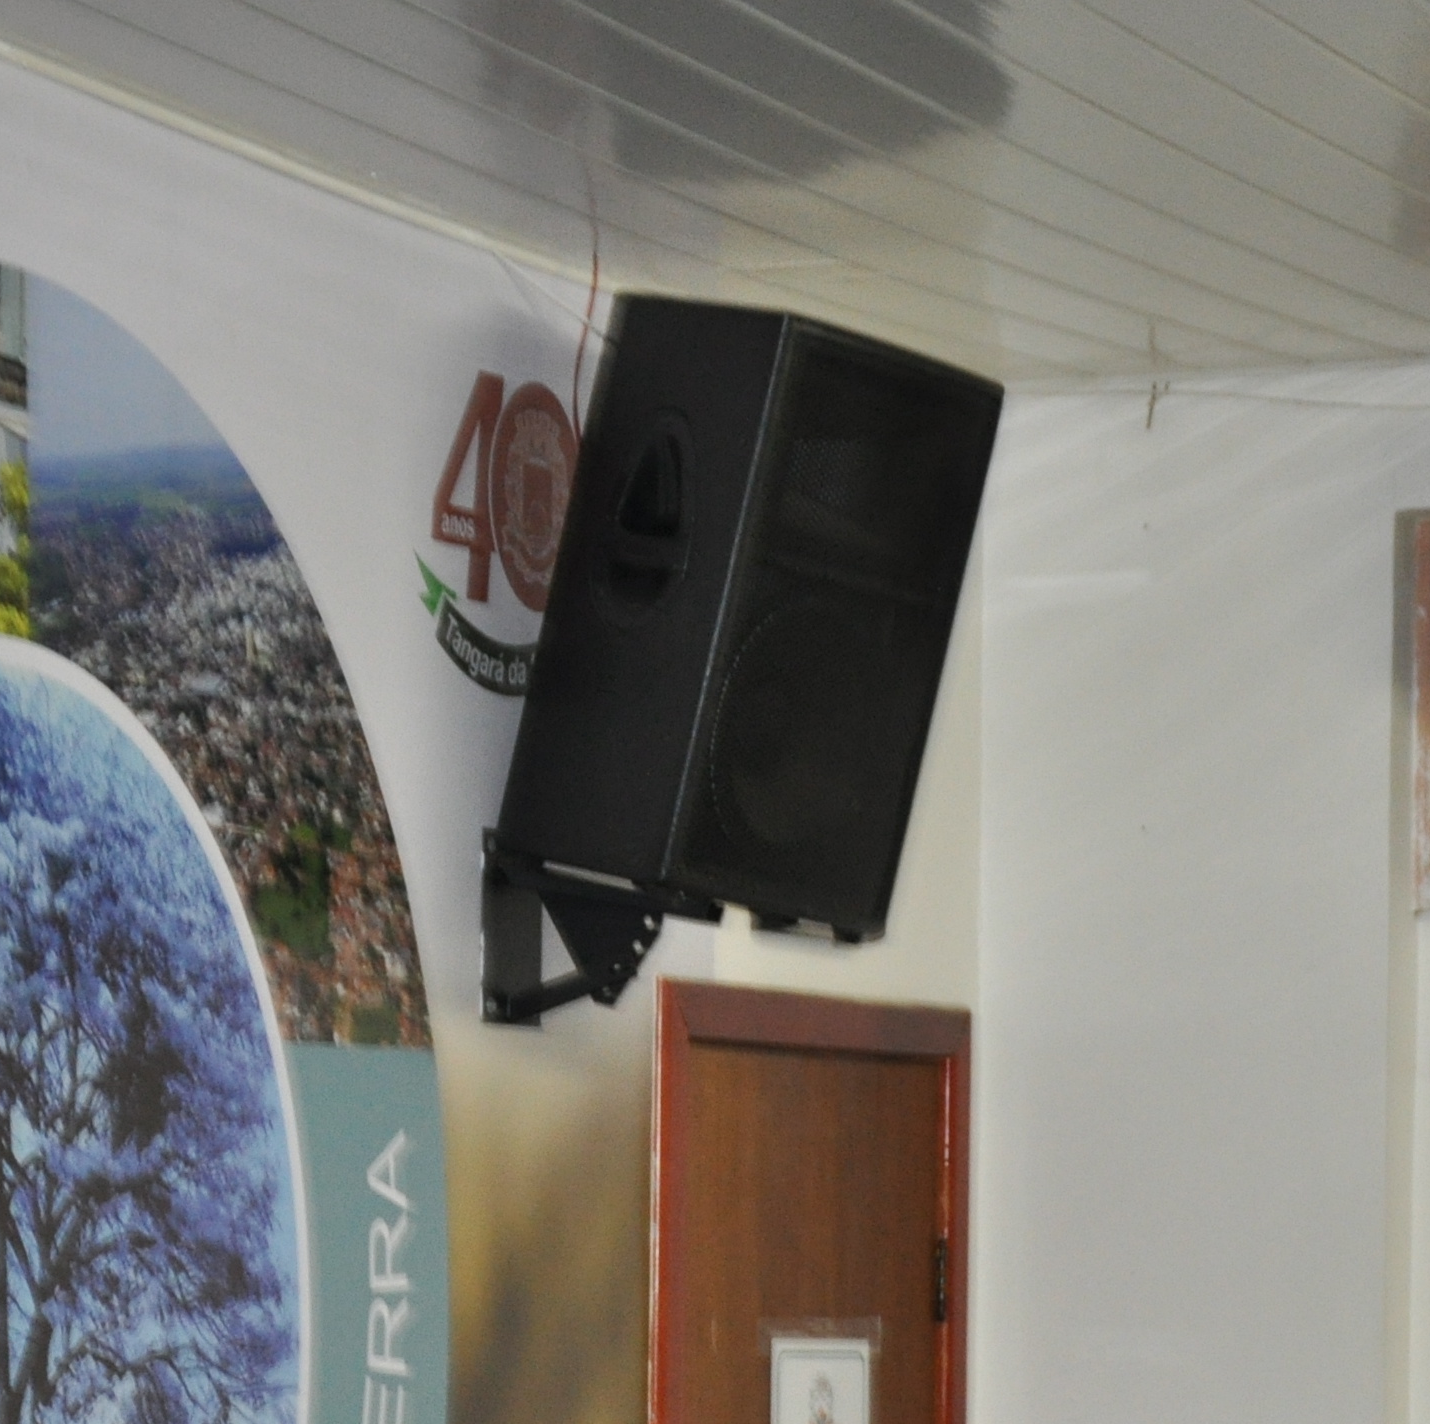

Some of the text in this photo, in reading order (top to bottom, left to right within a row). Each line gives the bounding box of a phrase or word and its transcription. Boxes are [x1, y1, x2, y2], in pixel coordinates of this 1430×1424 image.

[441, 512, 476, 538] anos
[444, 613, 527, 686] Tangará da
